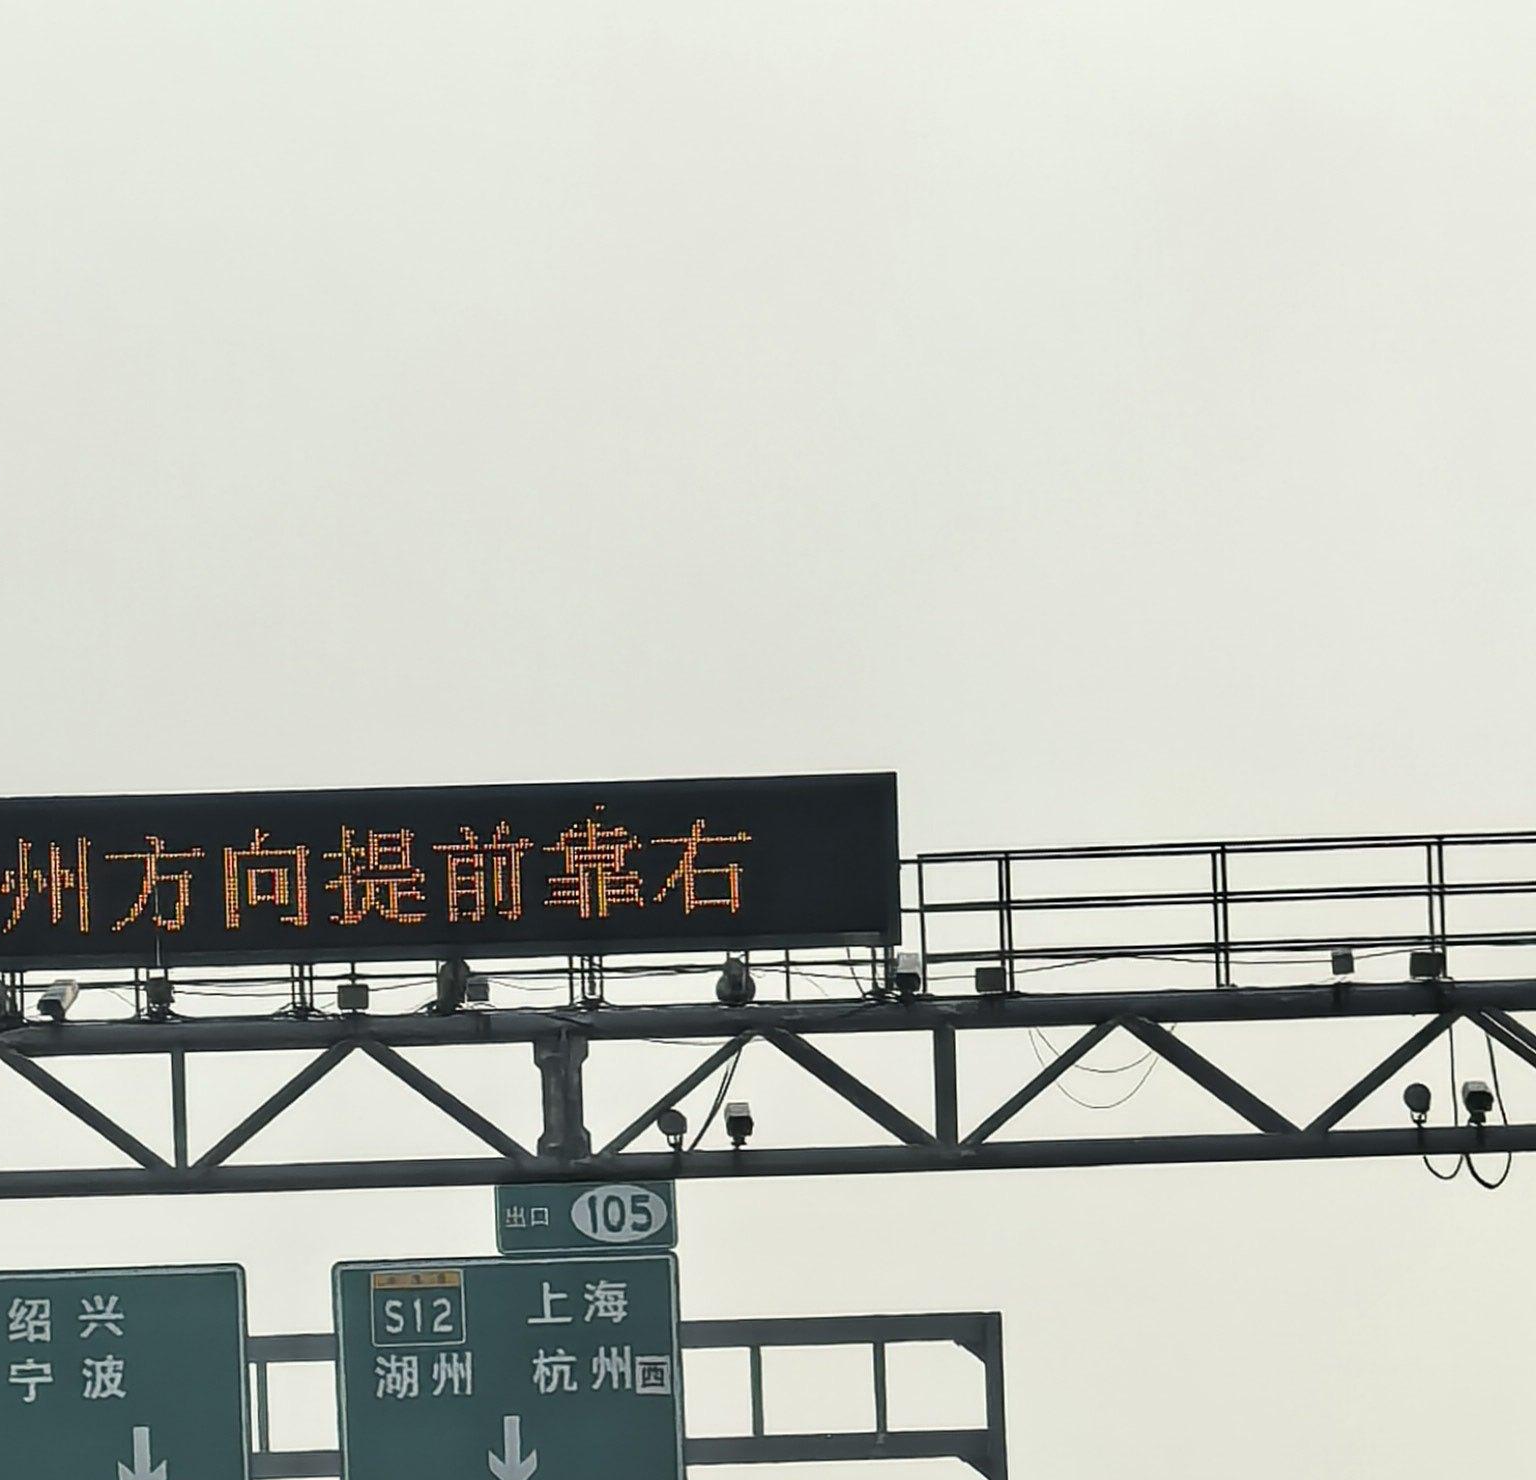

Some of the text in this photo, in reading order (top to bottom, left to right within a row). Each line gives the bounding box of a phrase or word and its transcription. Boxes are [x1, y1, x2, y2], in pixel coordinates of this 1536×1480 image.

[505, 1193, 654, 1235] 出口 105
[7, 1295, 126, 1343] 绍兴
[384, 1297, 454, 1334] S12
[527, 1279, 628, 1324] 上海
[8, 1354, 128, 1403] 宁波
[374, 1351, 473, 1400] 湖州
